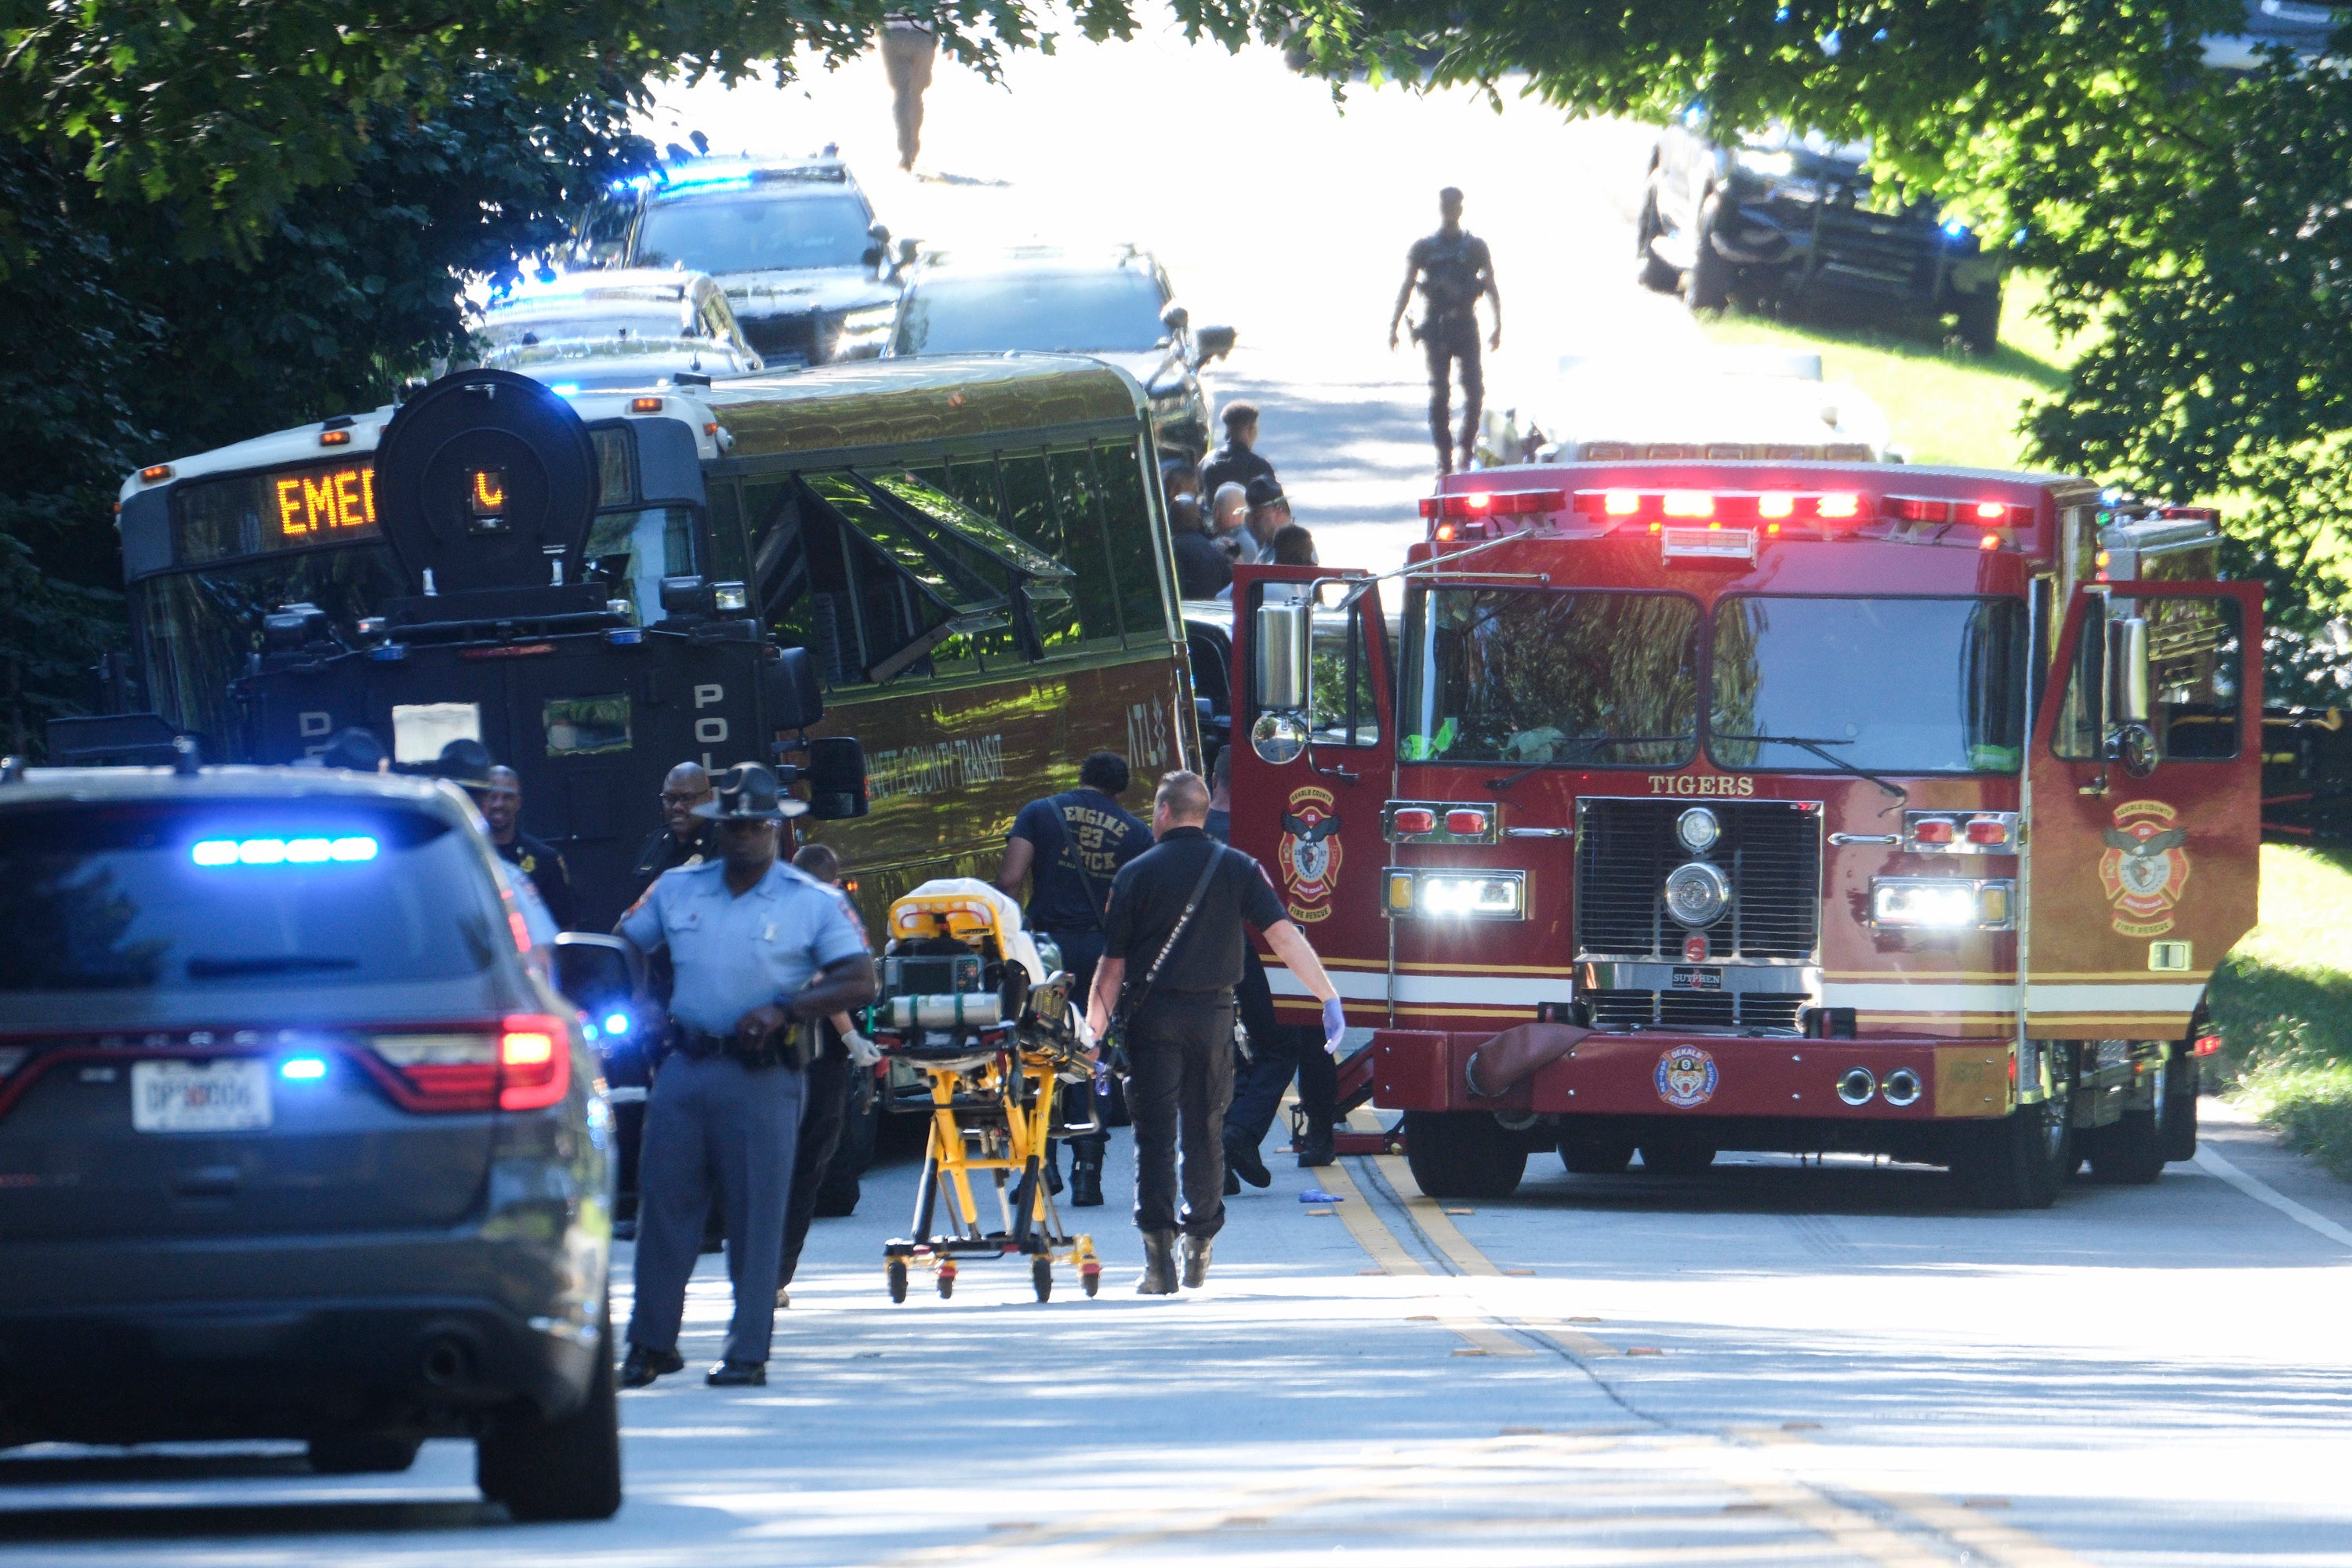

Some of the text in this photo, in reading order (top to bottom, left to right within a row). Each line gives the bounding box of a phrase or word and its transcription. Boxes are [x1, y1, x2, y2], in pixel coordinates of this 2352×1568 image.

[694, 684, 728, 801] POL
[902, 740, 954, 796] COUNTY
[955, 734, 1004, 786] TRANSIT
[1312, 789, 1332, 802] COUNTY
[1648, 775, 1754, 796] TIGERS
[1063, 806, 1130, 838] ENGINE
[1079, 826, 1104, 848] 23
[1290, 906, 1329, 920] FIRE RESCUE
[1673, 974, 1721, 984] SUTPHEN
[1671, 1048, 1704, 1058] DEKALB
[1658, 1060, 1668, 1093] ENGINE
[1704, 1061, 1715, 1093] TUCKER
[1668, 1094, 1704, 1105] GEORGIA
